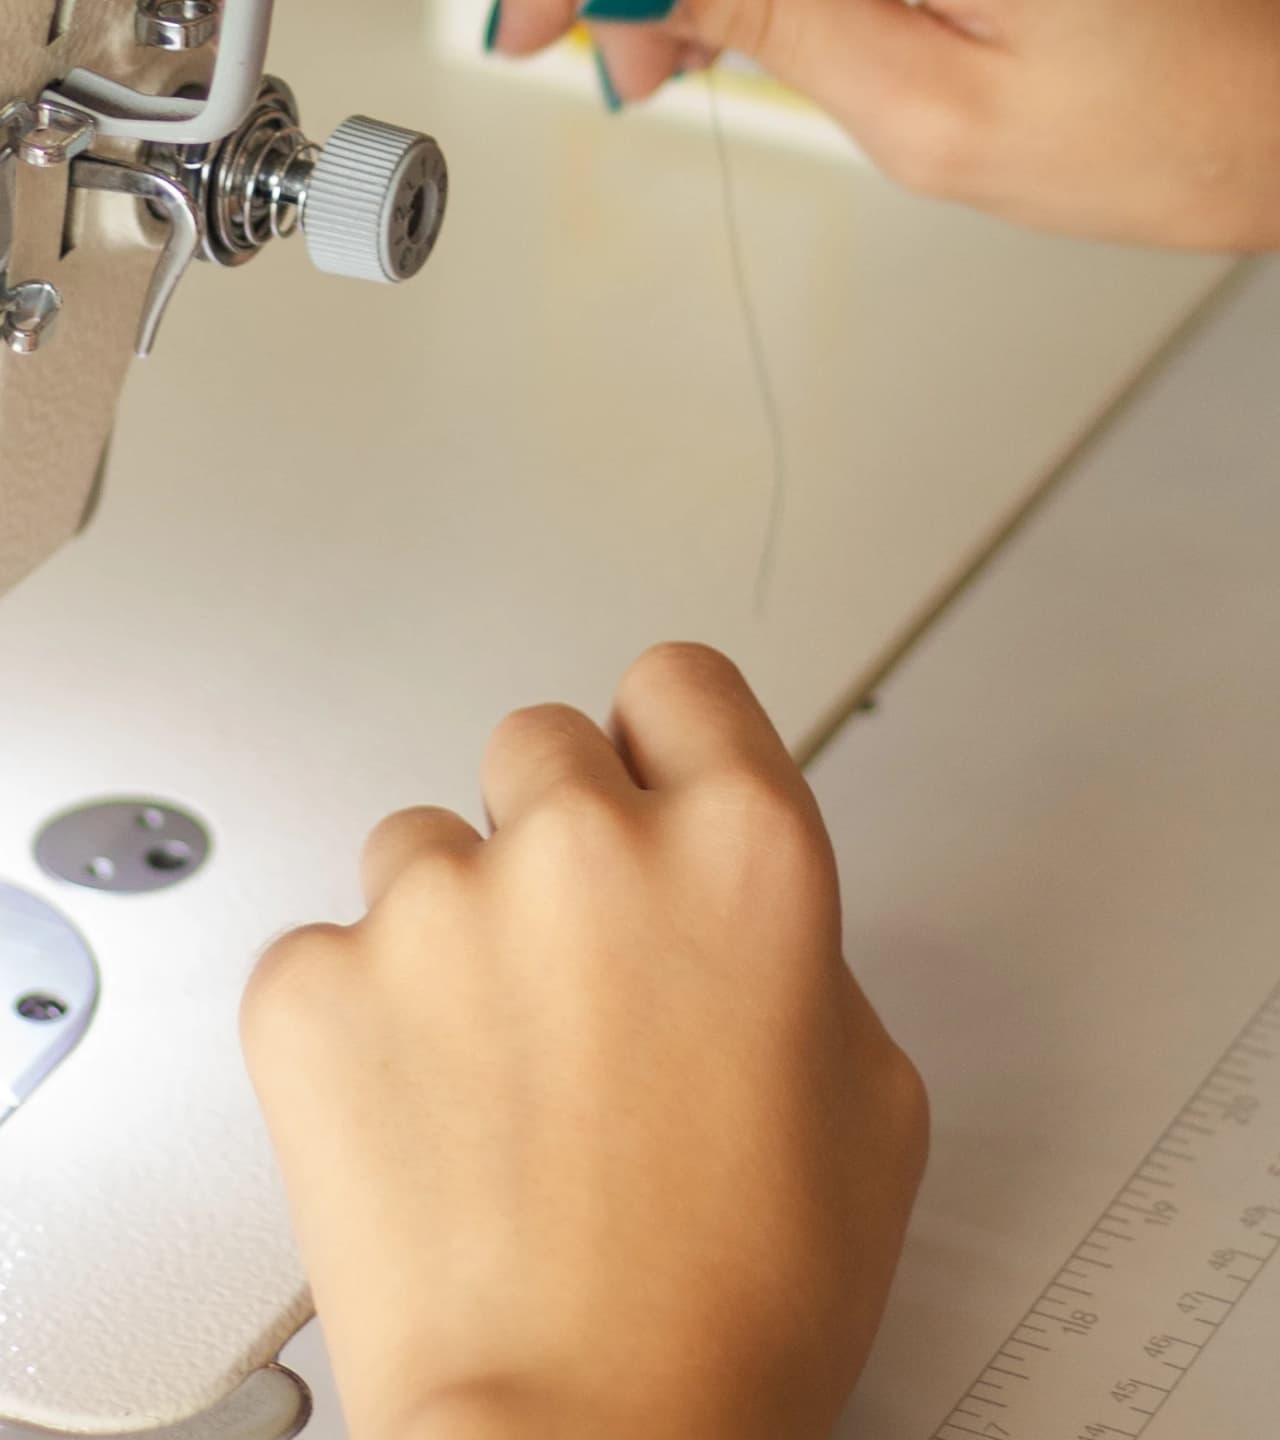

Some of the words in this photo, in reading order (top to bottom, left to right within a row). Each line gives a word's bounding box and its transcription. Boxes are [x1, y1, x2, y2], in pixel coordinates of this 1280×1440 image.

[1061, 1309, 1099, 1335] 18
[1110, 1380, 1140, 1404] 45
[1143, 1335, 1172, 1359] 46
[1176, 1291, 1203, 1314] 47
